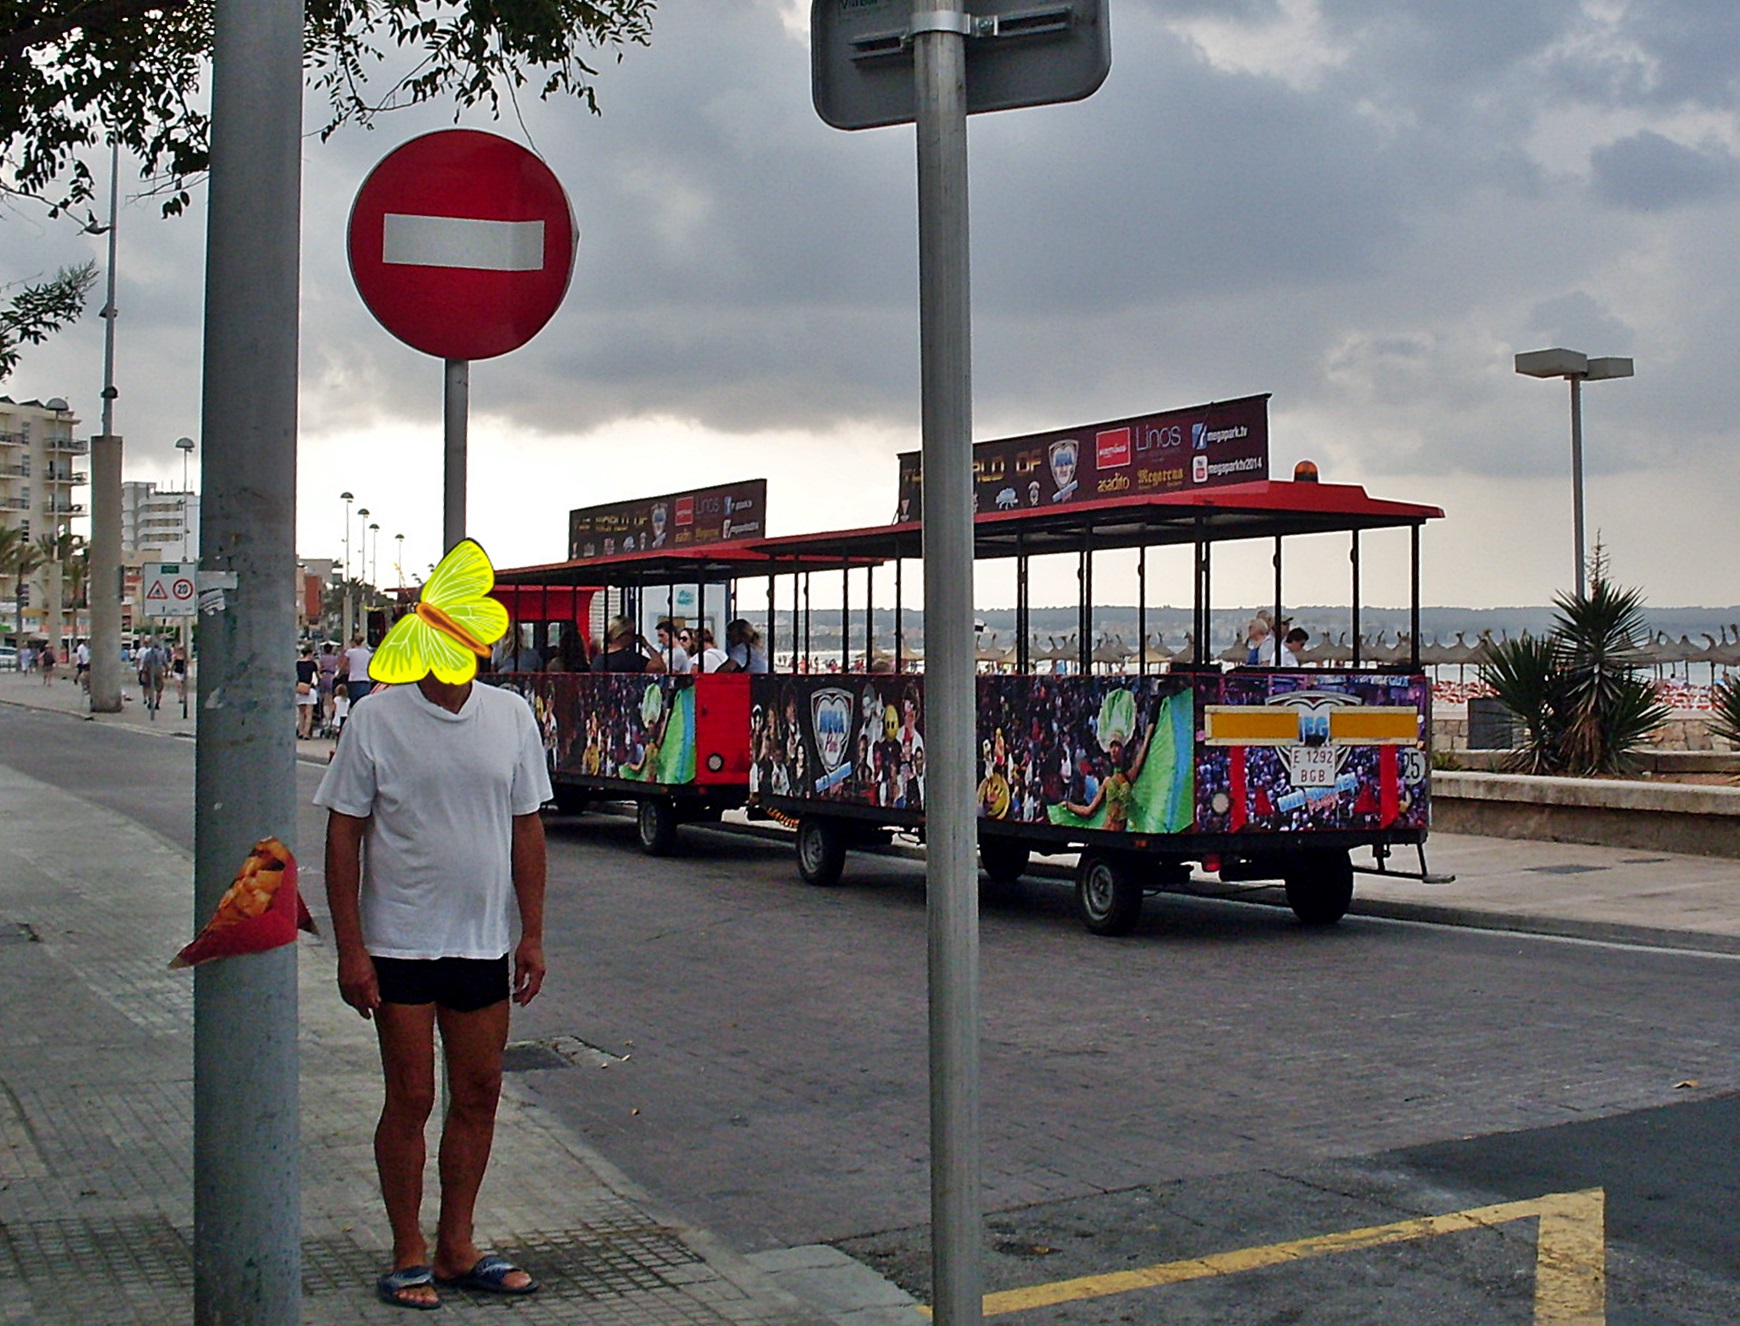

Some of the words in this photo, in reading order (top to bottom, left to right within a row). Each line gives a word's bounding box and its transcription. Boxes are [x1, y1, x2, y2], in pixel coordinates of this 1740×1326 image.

[1135, 424, 1181, 450] Linos
[177, 584, 188, 594] 20
[1294, 750, 1300, 763] E
[1307, 750, 1333, 764] 1292
[1404, 752, 1420, 780] 25
[1301, 769, 1325, 782] BGB
